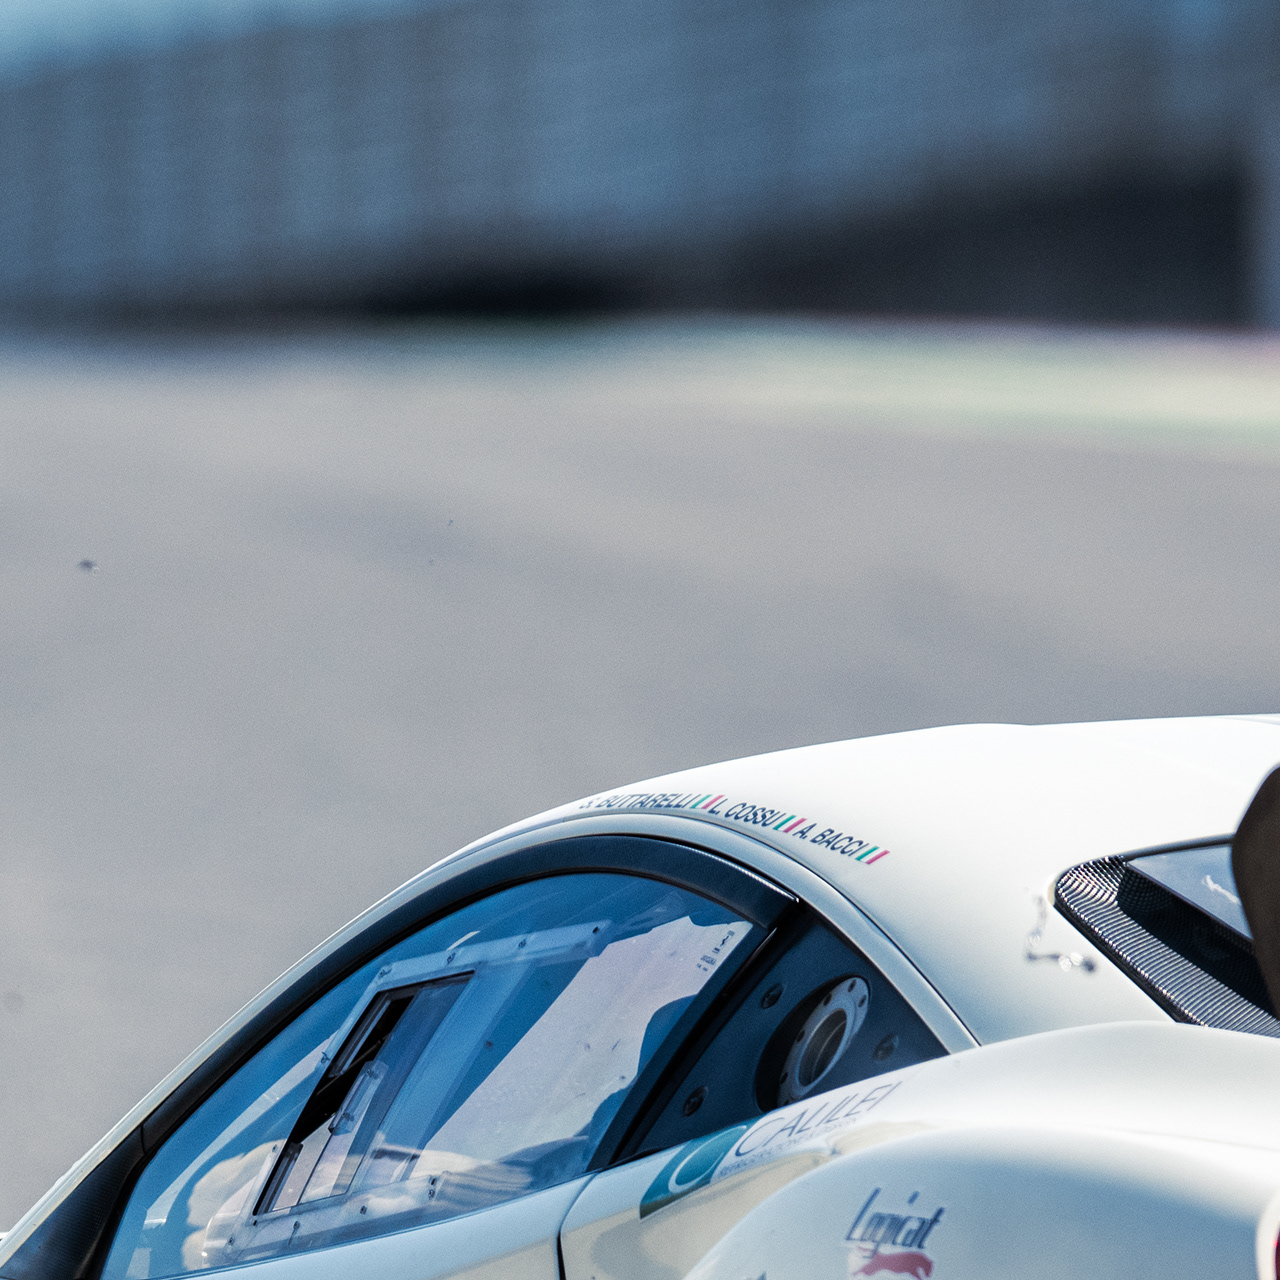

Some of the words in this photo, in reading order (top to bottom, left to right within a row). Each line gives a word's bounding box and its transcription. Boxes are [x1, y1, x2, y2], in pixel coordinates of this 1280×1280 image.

[724, 802, 779, 828] COSSU
[792, 822, 815, 840] A.
[814, 827, 869, 858] BACCI
